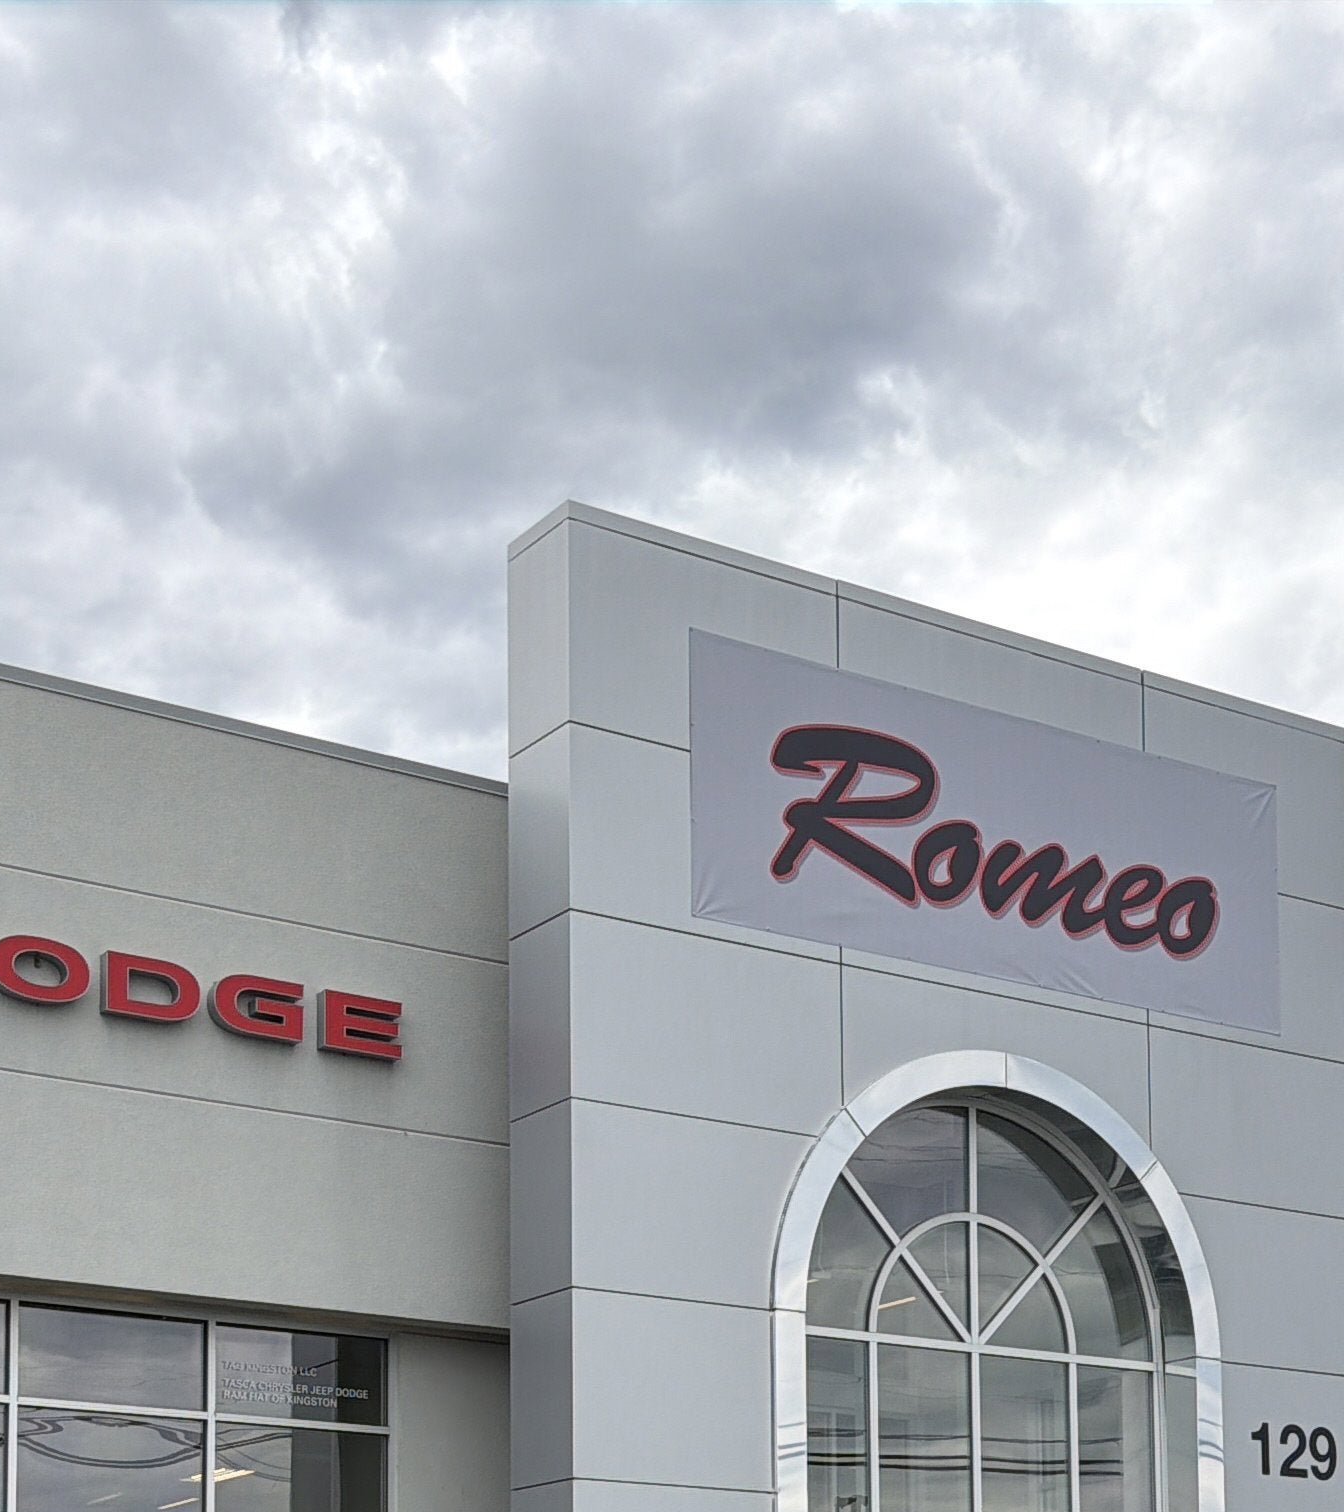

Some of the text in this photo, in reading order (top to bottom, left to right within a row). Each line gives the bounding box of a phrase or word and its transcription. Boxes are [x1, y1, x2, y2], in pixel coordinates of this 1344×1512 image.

[769, 723, 1222, 961] Romeo
[299, 1366, 318, 1378] LLC
[221, 1377, 368, 1400] TASCA CHRYSLER JEEP DODGE
[222, 1389, 247, 1401] RAM
[285, 1394, 338, 1409] KINGSTON
[1251, 1422, 1337, 1481] 129
